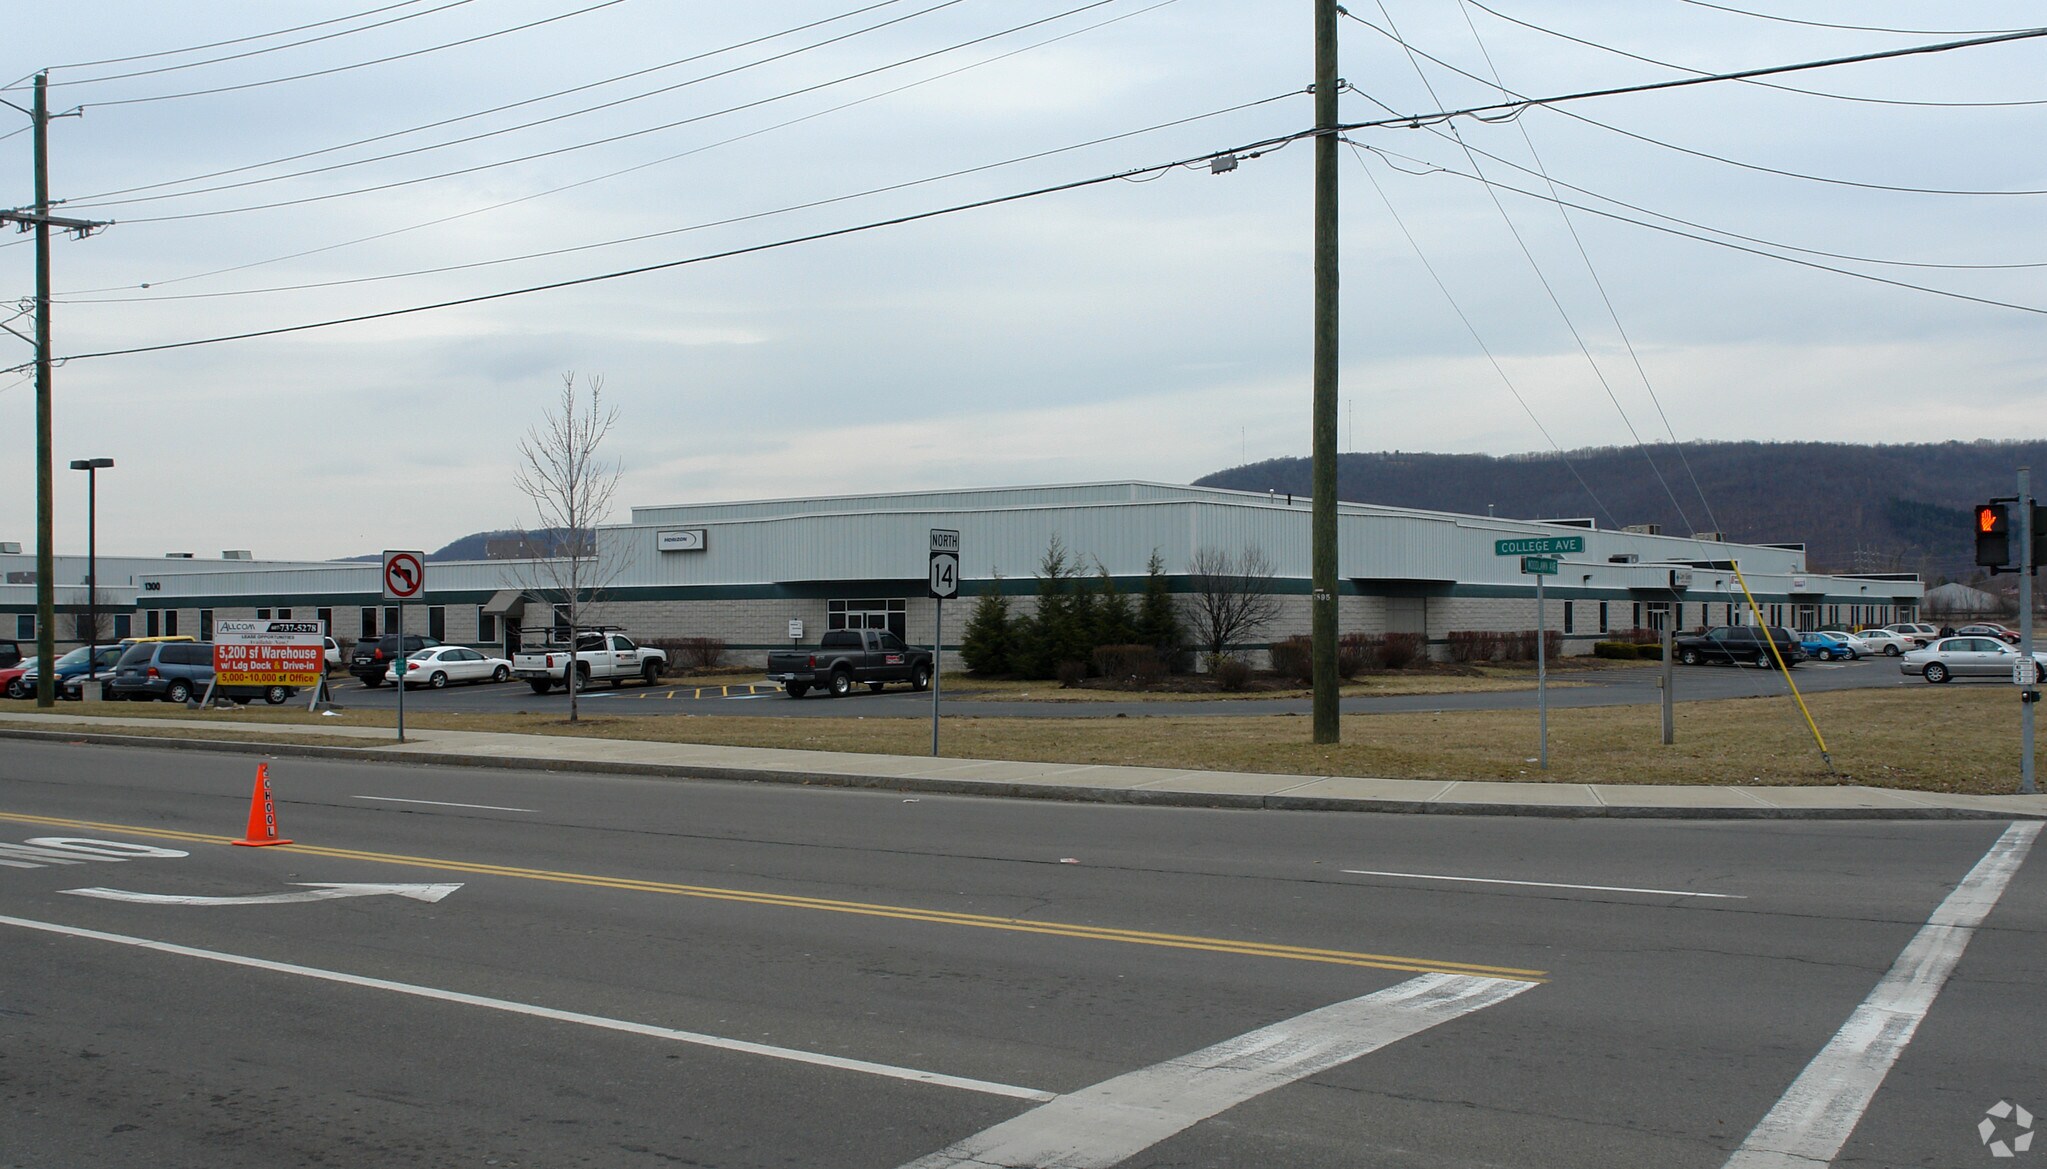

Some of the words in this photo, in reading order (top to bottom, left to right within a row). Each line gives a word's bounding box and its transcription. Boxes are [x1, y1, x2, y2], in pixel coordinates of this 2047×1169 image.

[932, 534, 958, 547] NORTH
[1501, 541, 1549, 553] COLLEGE
[1555, 540, 1577, 550] AVE
[935, 563, 953, 588] 14
[145, 582, 161, 590] 1300
[220, 621, 256, 632] ALLCOM
[219, 646, 247, 661] 5,200
[249, 646, 259, 659] sf
[261, 646, 317, 659] Warehouse
[220, 661, 230, 670] w/
[232, 661, 248, 672] Ldg
[250, 661, 272, 670] Dock
[273, 661, 281, 670] &
[282, 661, 315, 670] Drive-in
[279, 673, 287, 682] sf
[289, 674, 314, 683] Office
[263, 766, 275, 837] SCHOOL
